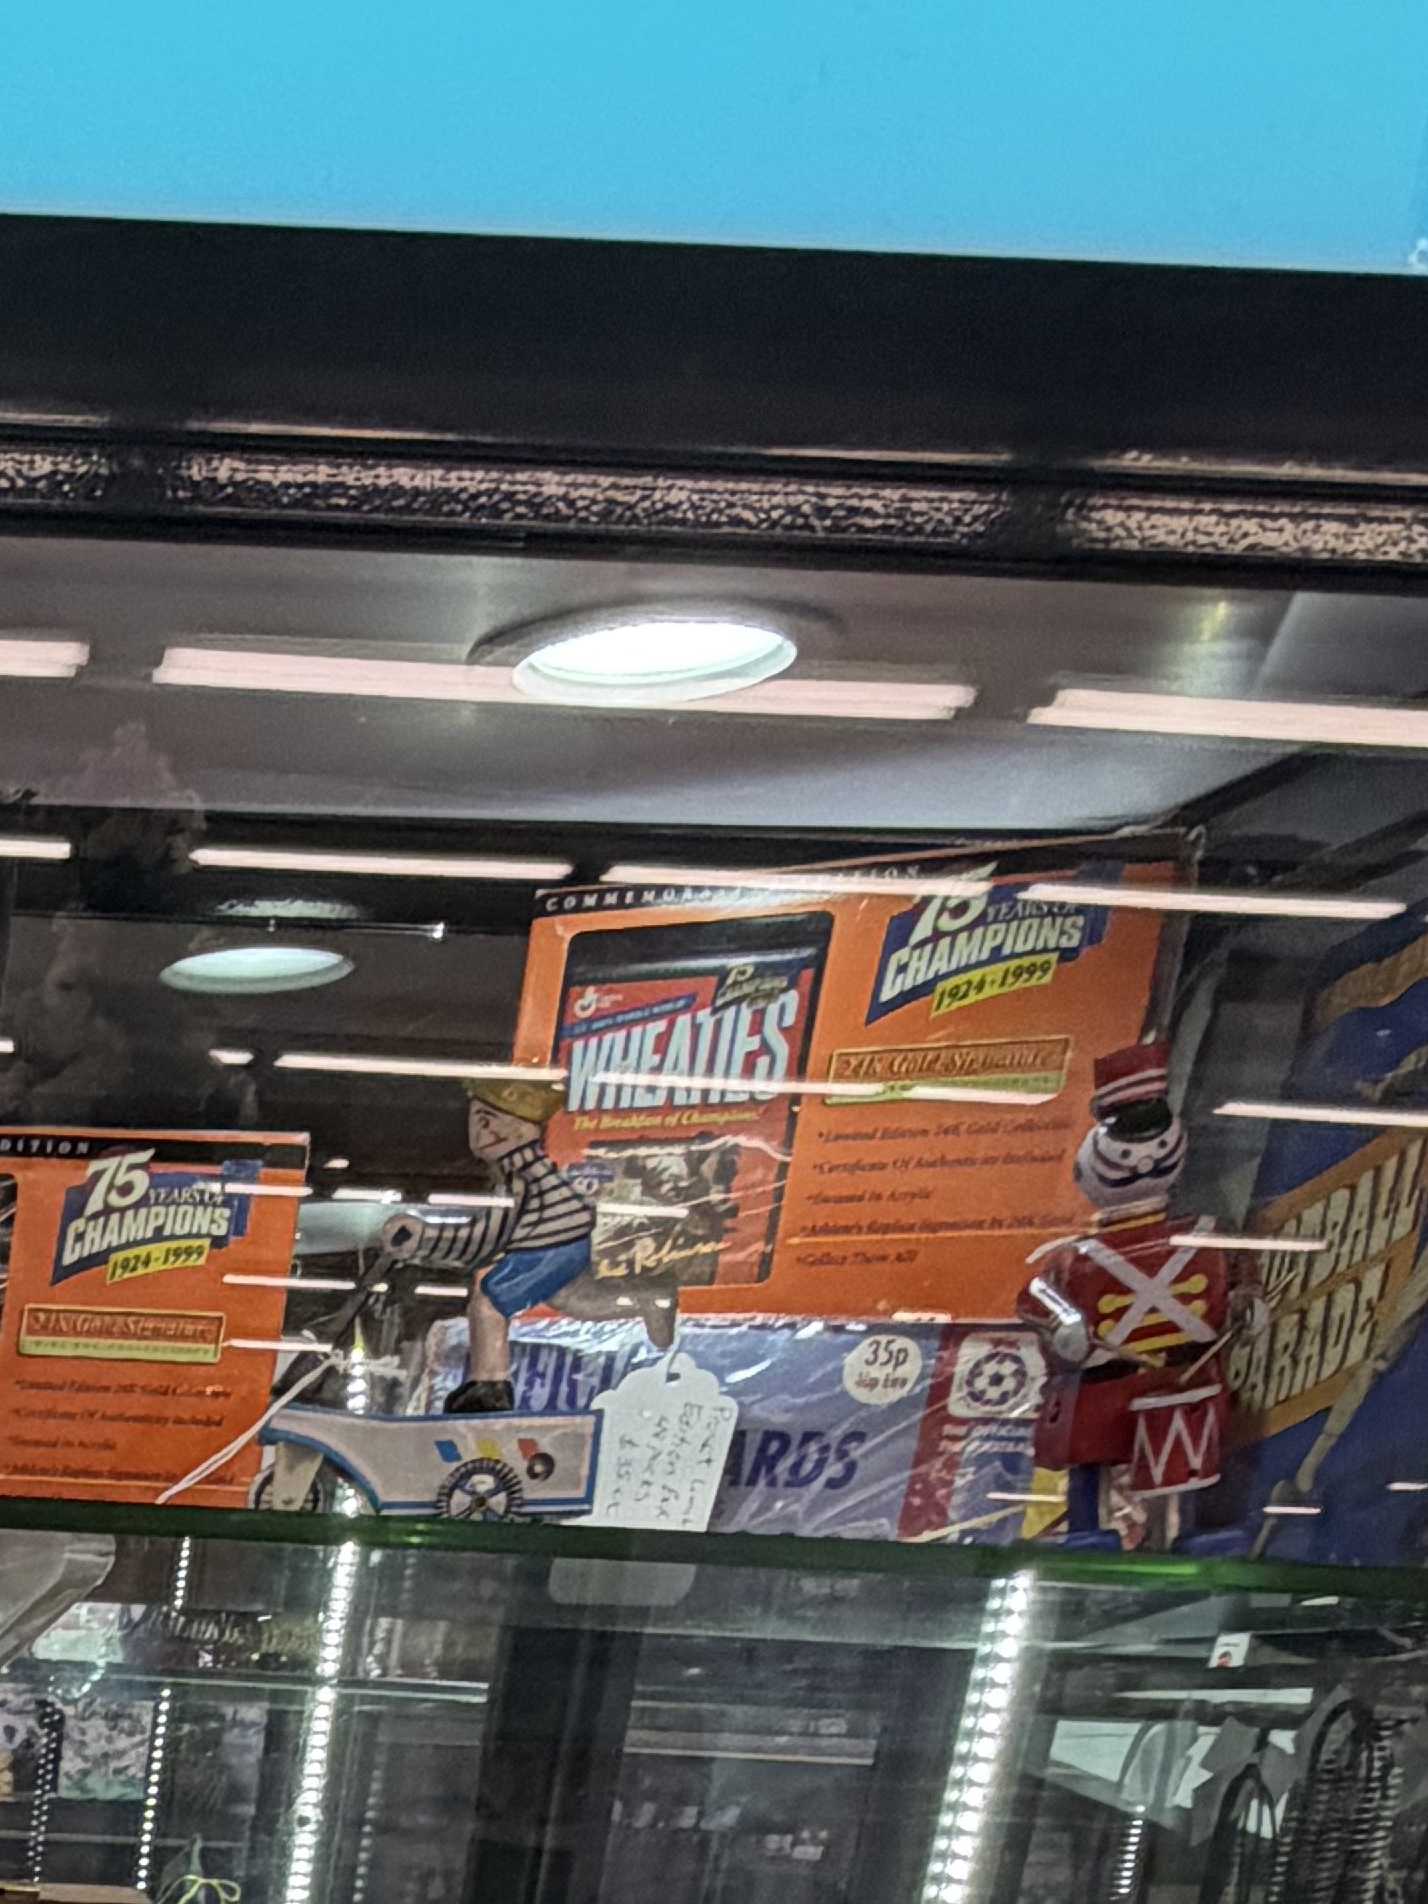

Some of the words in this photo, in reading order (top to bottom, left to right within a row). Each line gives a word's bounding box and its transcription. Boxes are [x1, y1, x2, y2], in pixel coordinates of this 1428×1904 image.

[880, 915, 1084, 1004] CHAMPIONS
[566, 988, 799, 1113] WHEATIES
[84, 1148, 156, 1217] 75
[62, 1206, 231, 1267] CHAMPIONS
[109, 1244, 206, 1280] 1924-1999
[864, 1338, 910, 1372] 35p
[724, 1429, 868, 1490] ARDS
